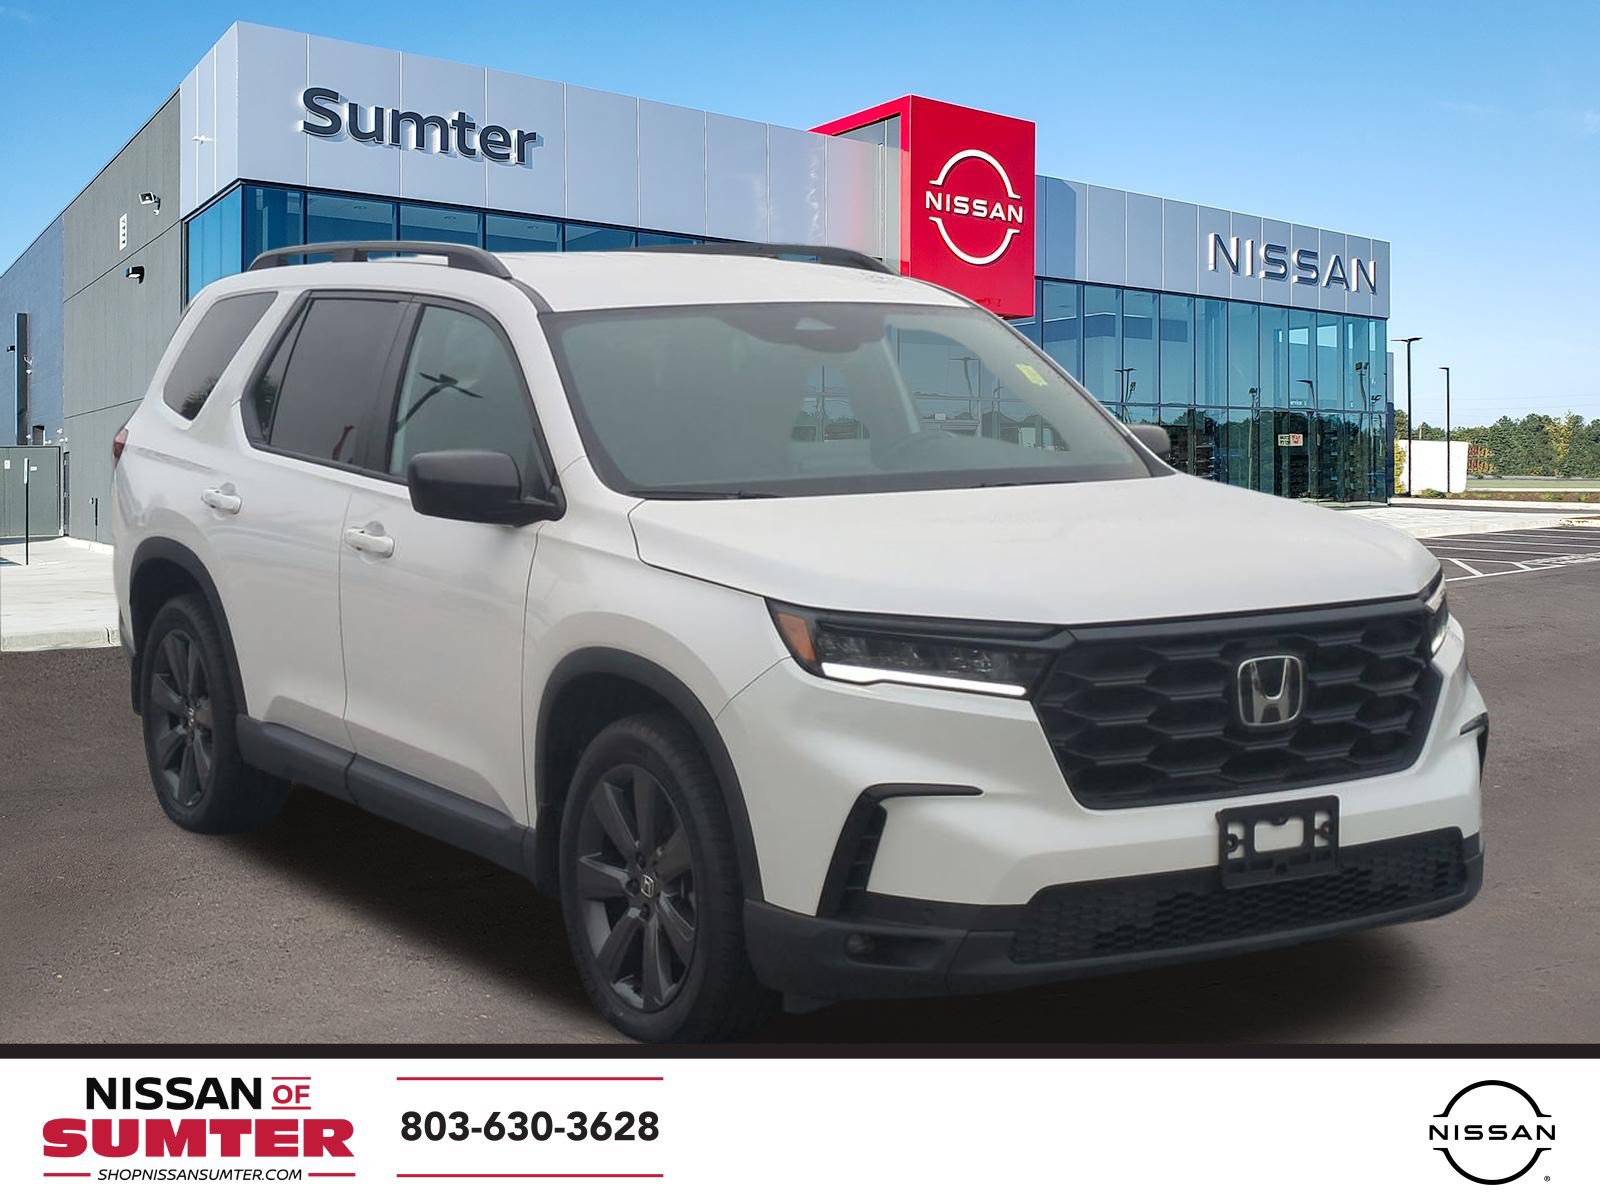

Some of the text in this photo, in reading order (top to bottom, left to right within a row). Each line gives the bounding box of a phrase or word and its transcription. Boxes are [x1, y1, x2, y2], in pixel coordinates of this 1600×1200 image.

[301, 87, 537, 166] Sumter
[925, 189, 1024, 225] NISSAN
[1207, 232, 1378, 294] NISSAN
